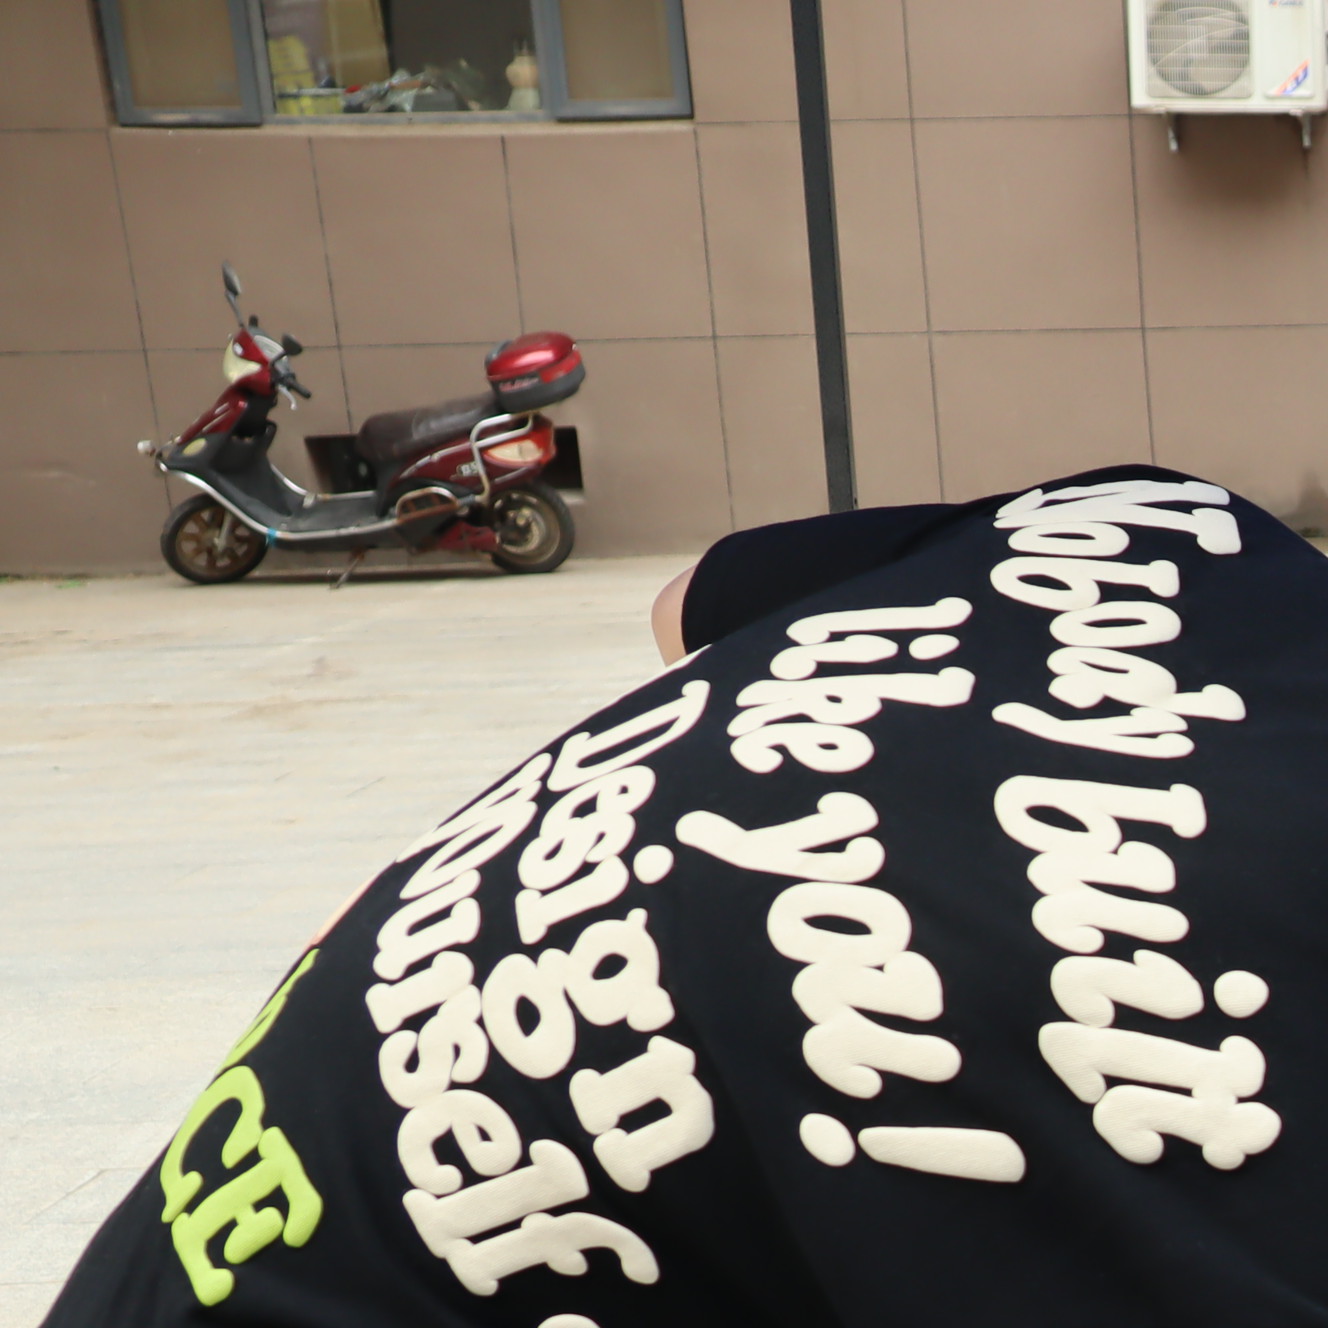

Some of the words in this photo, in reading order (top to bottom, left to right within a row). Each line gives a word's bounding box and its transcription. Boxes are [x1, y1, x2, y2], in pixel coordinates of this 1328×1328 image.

[727, 597, 976, 773] like
[990, 480, 1245, 758] Nobody
[515, 680, 715, 1192] Design
[994, 775, 1282, 1170] built
